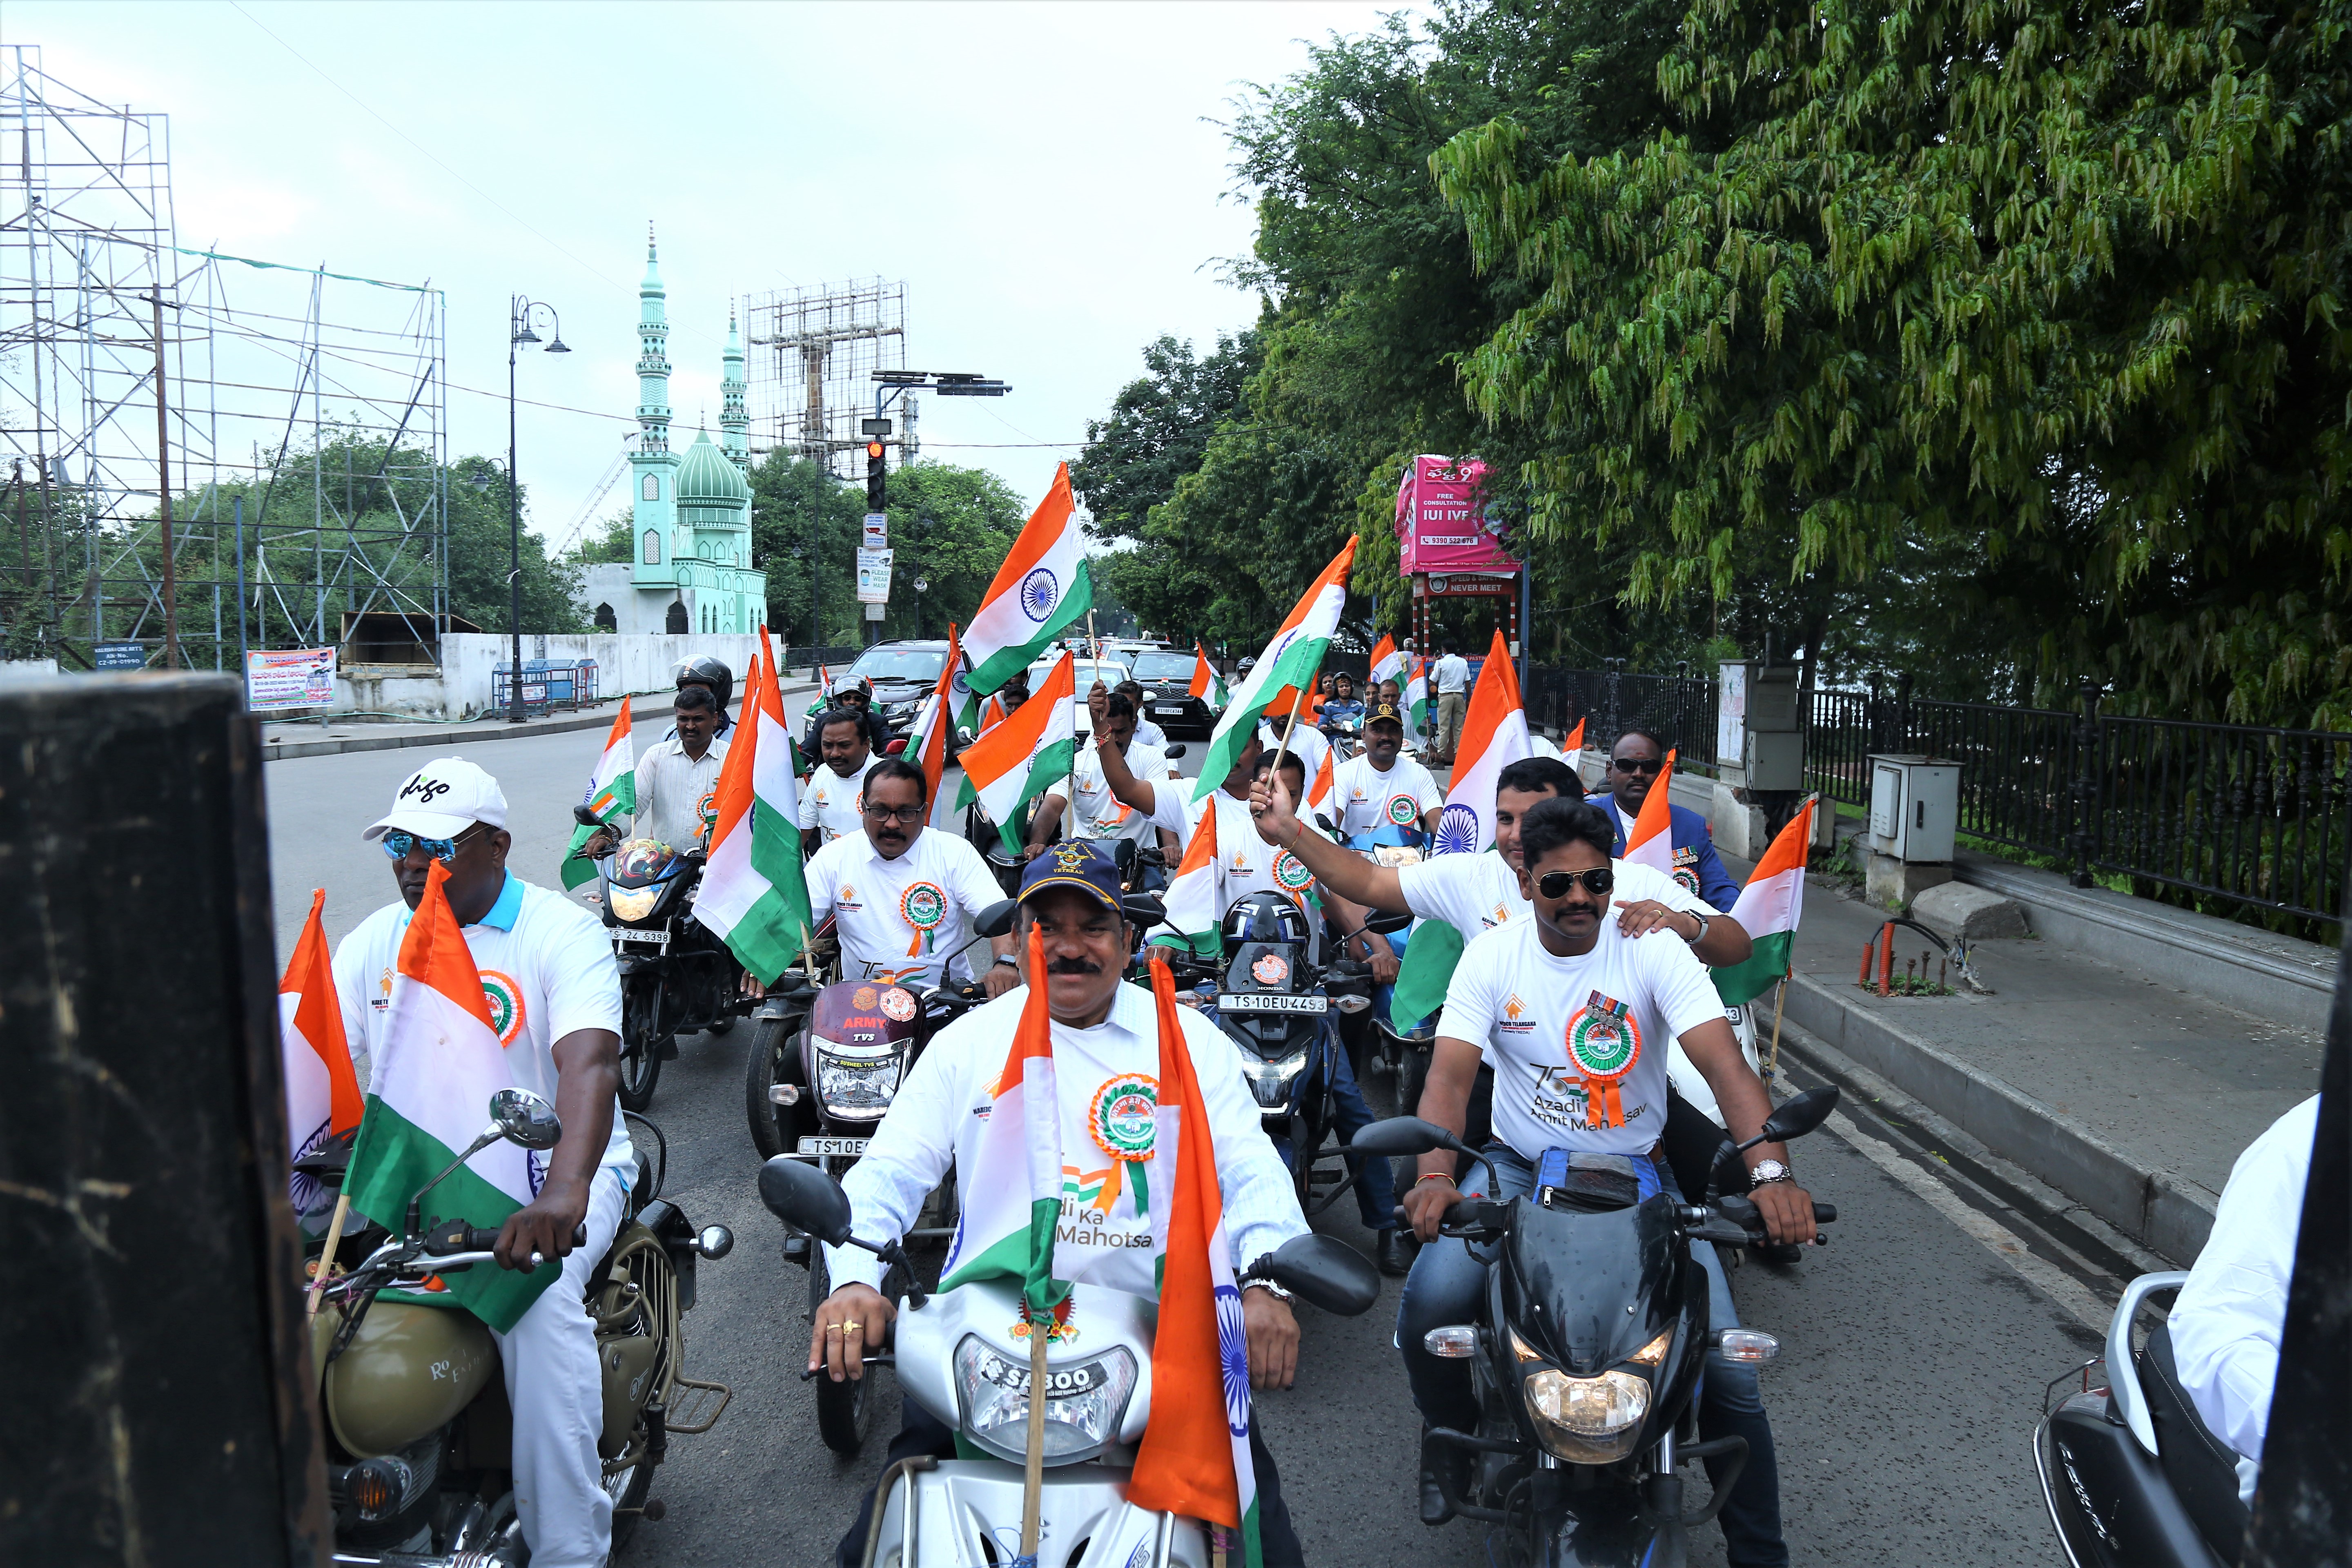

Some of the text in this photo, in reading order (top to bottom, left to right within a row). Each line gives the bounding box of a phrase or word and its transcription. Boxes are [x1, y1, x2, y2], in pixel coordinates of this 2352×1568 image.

[1424, 510, 1468, 521] IUI IVF
[644, 933, 668, 942] 5398
[1234, 996, 1324, 1010] TS10EU4493
[843, 1017, 886, 1029] ARMY
[853, 1033, 875, 1041] TVS
[973, 1106, 992, 1115] NAREDC
[1535, 1095, 1580, 1113] Azadi
[1531, 1109, 1568, 1126] Amrit
[1570, 1103, 1647, 1131] Mahsav
[815, 1140, 869, 1153] TS10E
[1079, 1209, 1103, 1225] Ka
[1056, 1225, 1155, 1248] Mahotsa
